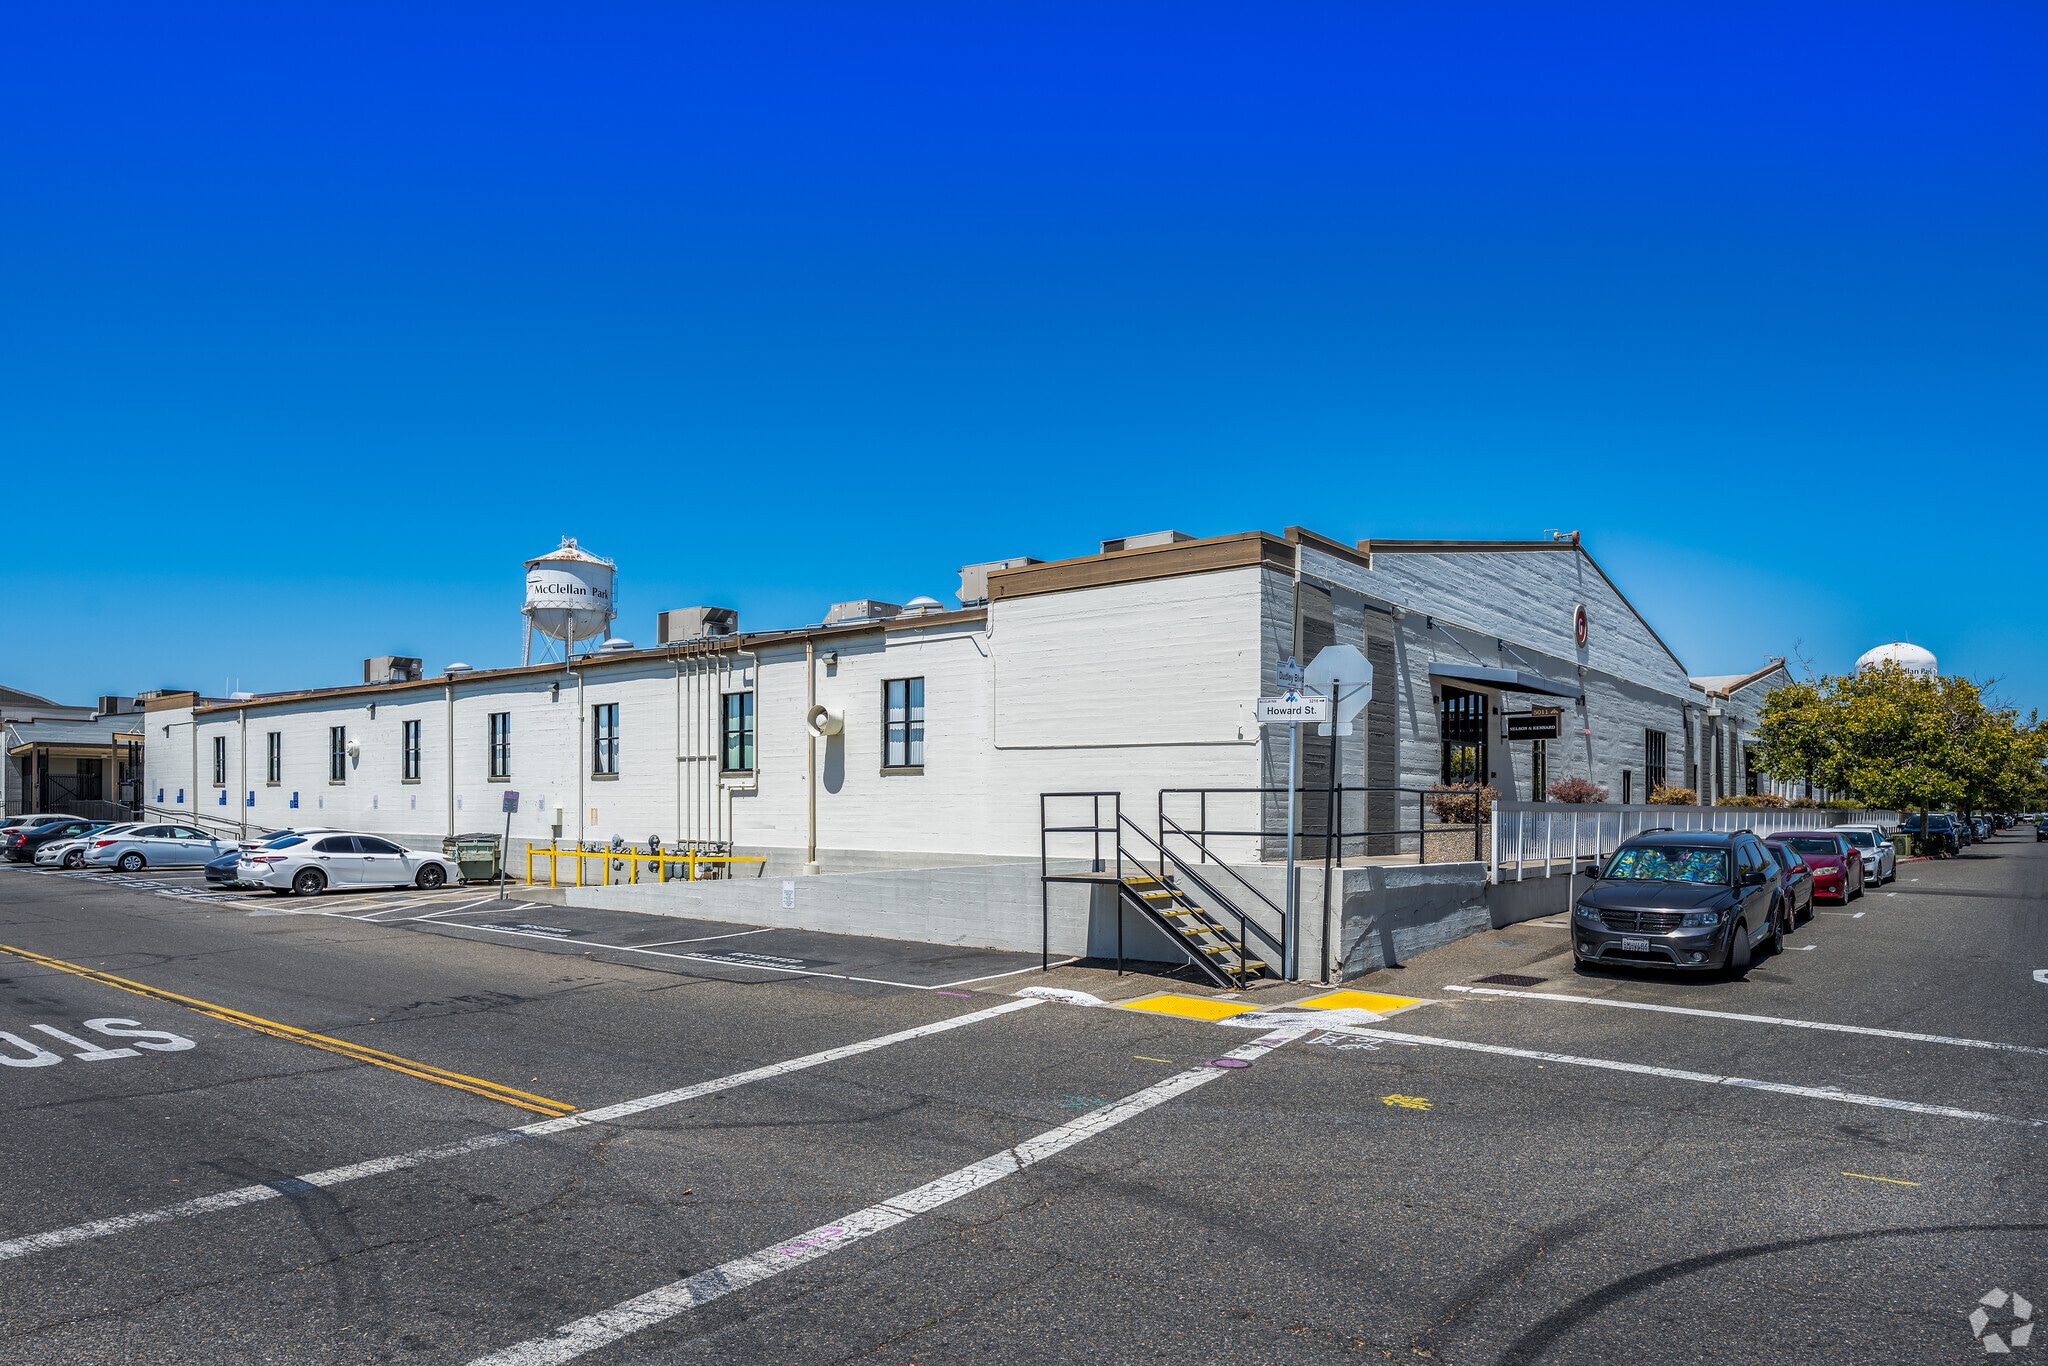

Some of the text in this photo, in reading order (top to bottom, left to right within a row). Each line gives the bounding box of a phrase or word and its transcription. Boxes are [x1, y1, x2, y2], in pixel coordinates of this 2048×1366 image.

[534, 583, 609, 600] McClellan Park
[1279, 671, 1293, 683] Dudley
[1267, 705, 1317, 715] Howard St.
